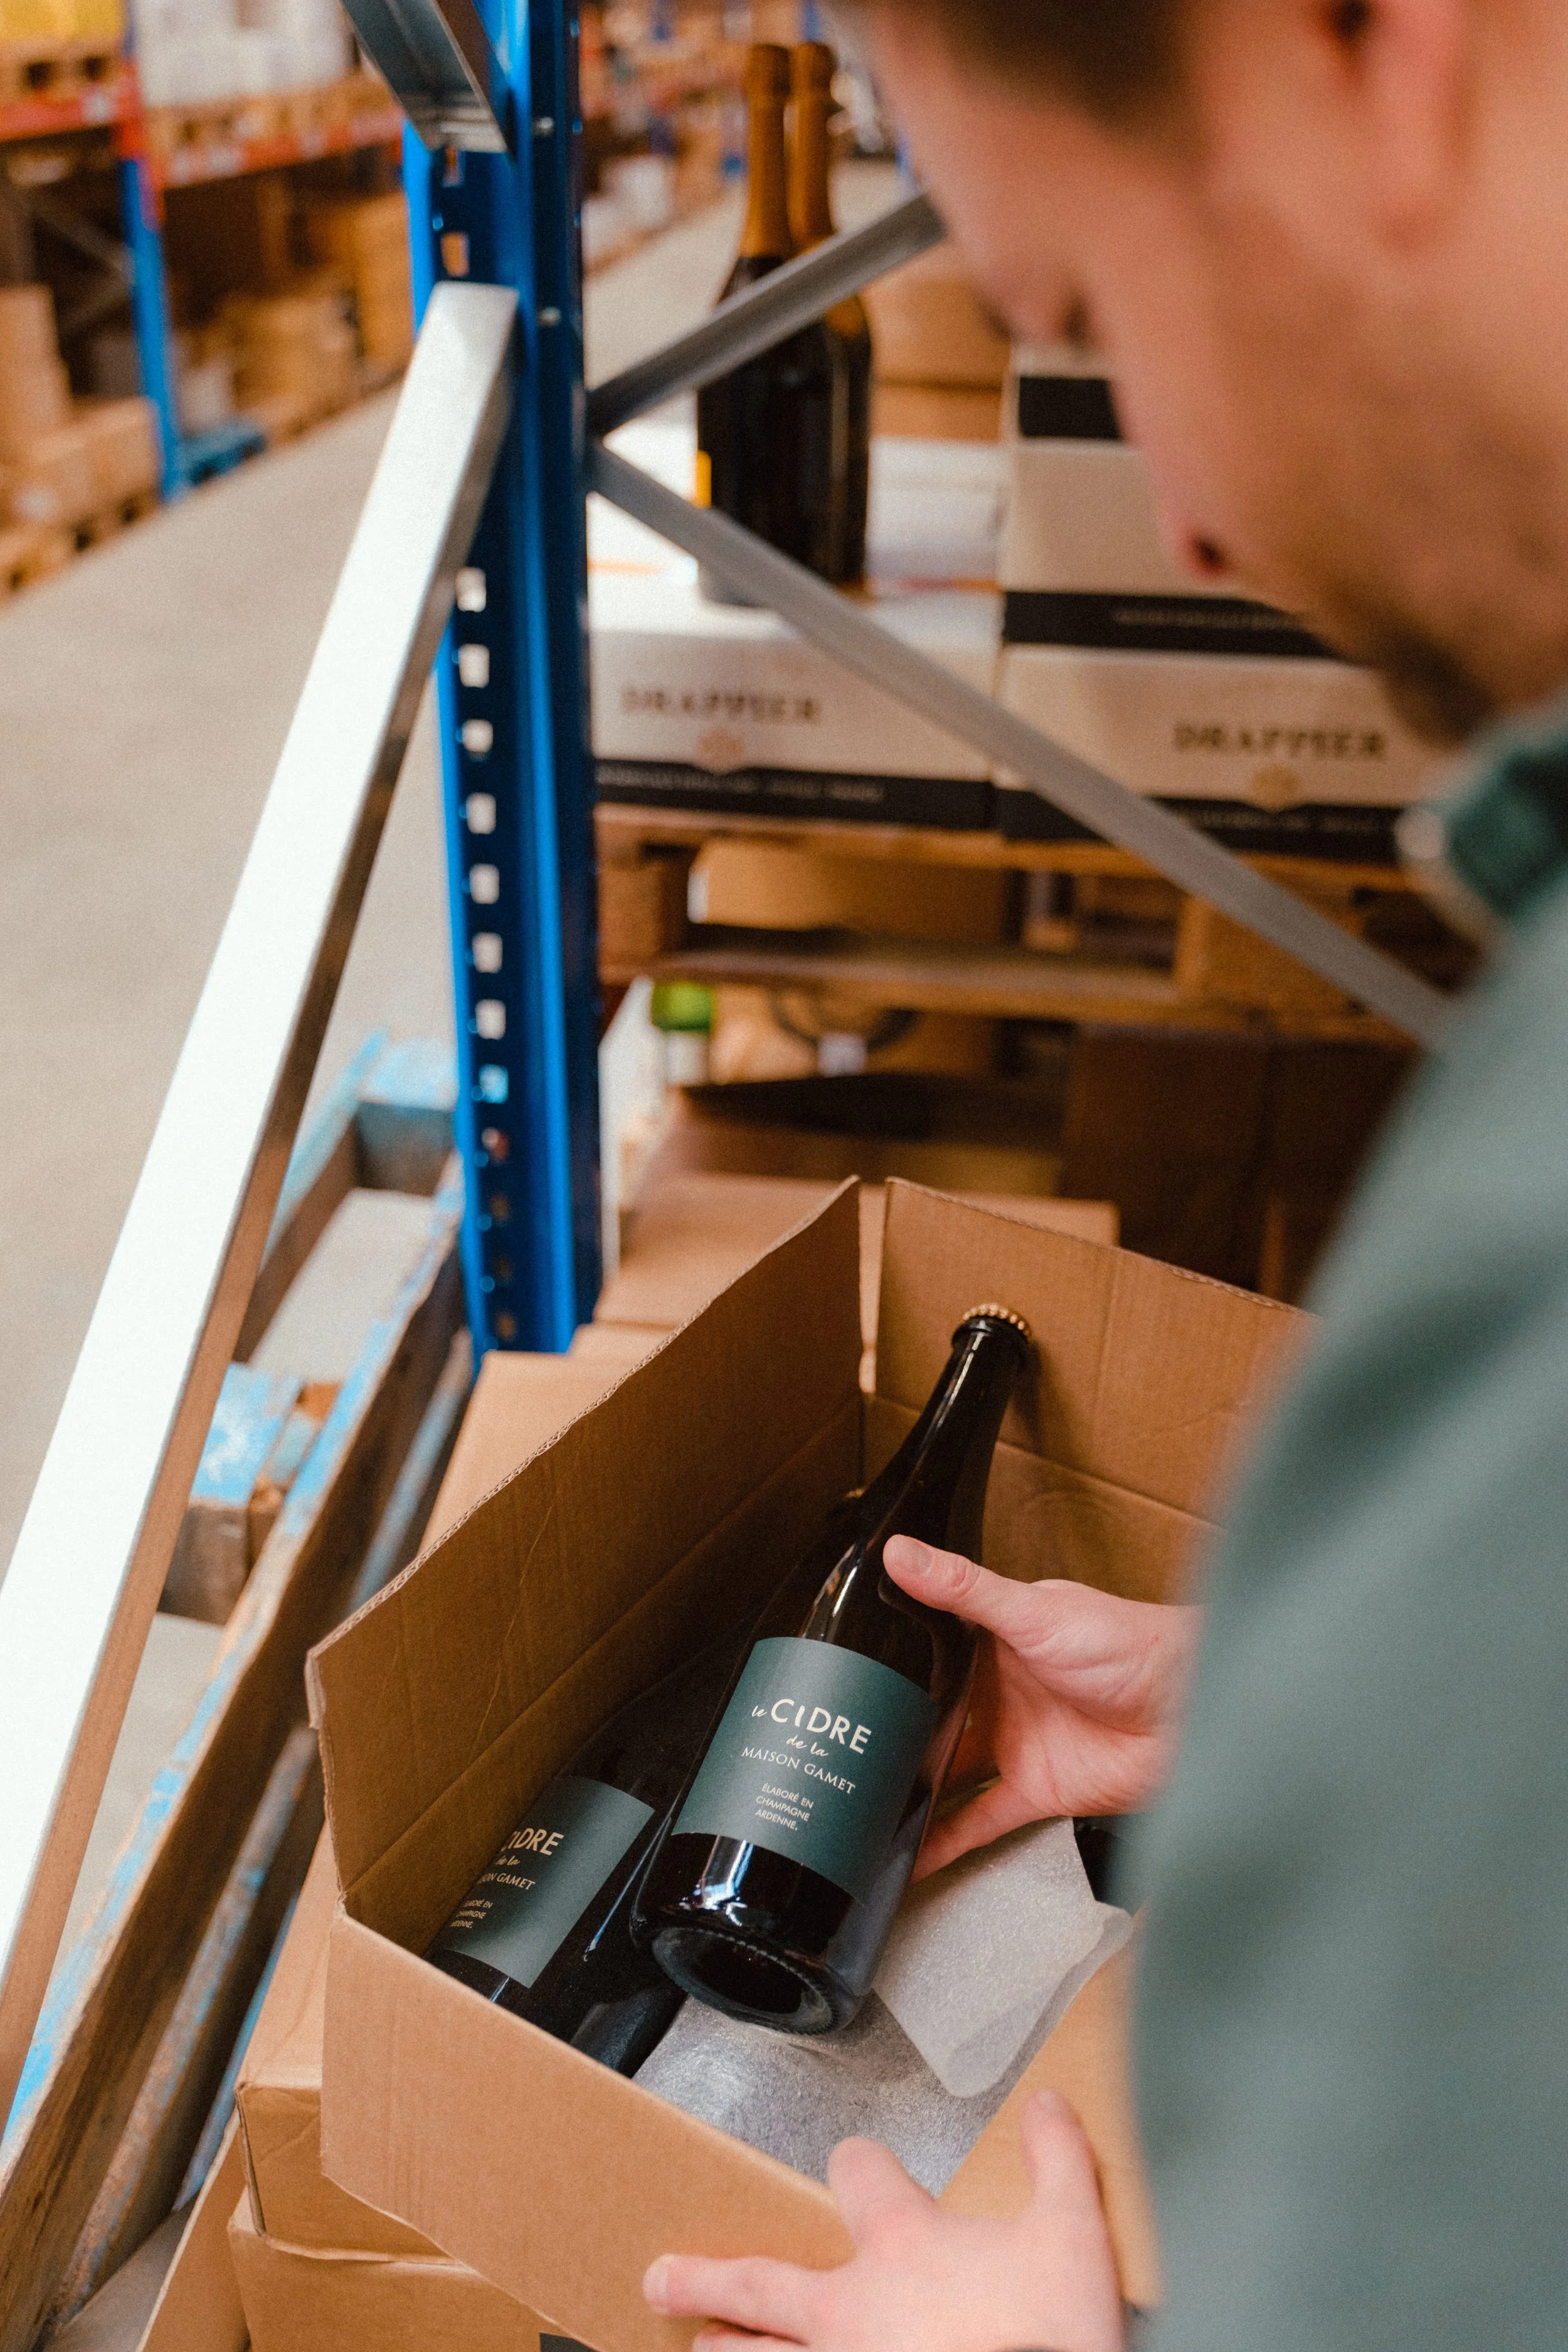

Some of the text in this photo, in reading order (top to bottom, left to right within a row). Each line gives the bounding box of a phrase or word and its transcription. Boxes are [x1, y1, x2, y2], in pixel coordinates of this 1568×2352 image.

[1174, 723, 1384, 760] DRAPPIER
[751, 1698, 872, 1754] le CIDRE
[786, 1735, 829, 1757] de la
[741, 1747, 856, 1794] MAISON GAMET
[756, 1796, 810, 1821] CHAMPAGNE
[761, 1782, 813, 1809] ÉLABORÉ EN
[755, 1809, 798, 1831] ARDENNE.
[497, 1873, 536, 1890] GAMET
